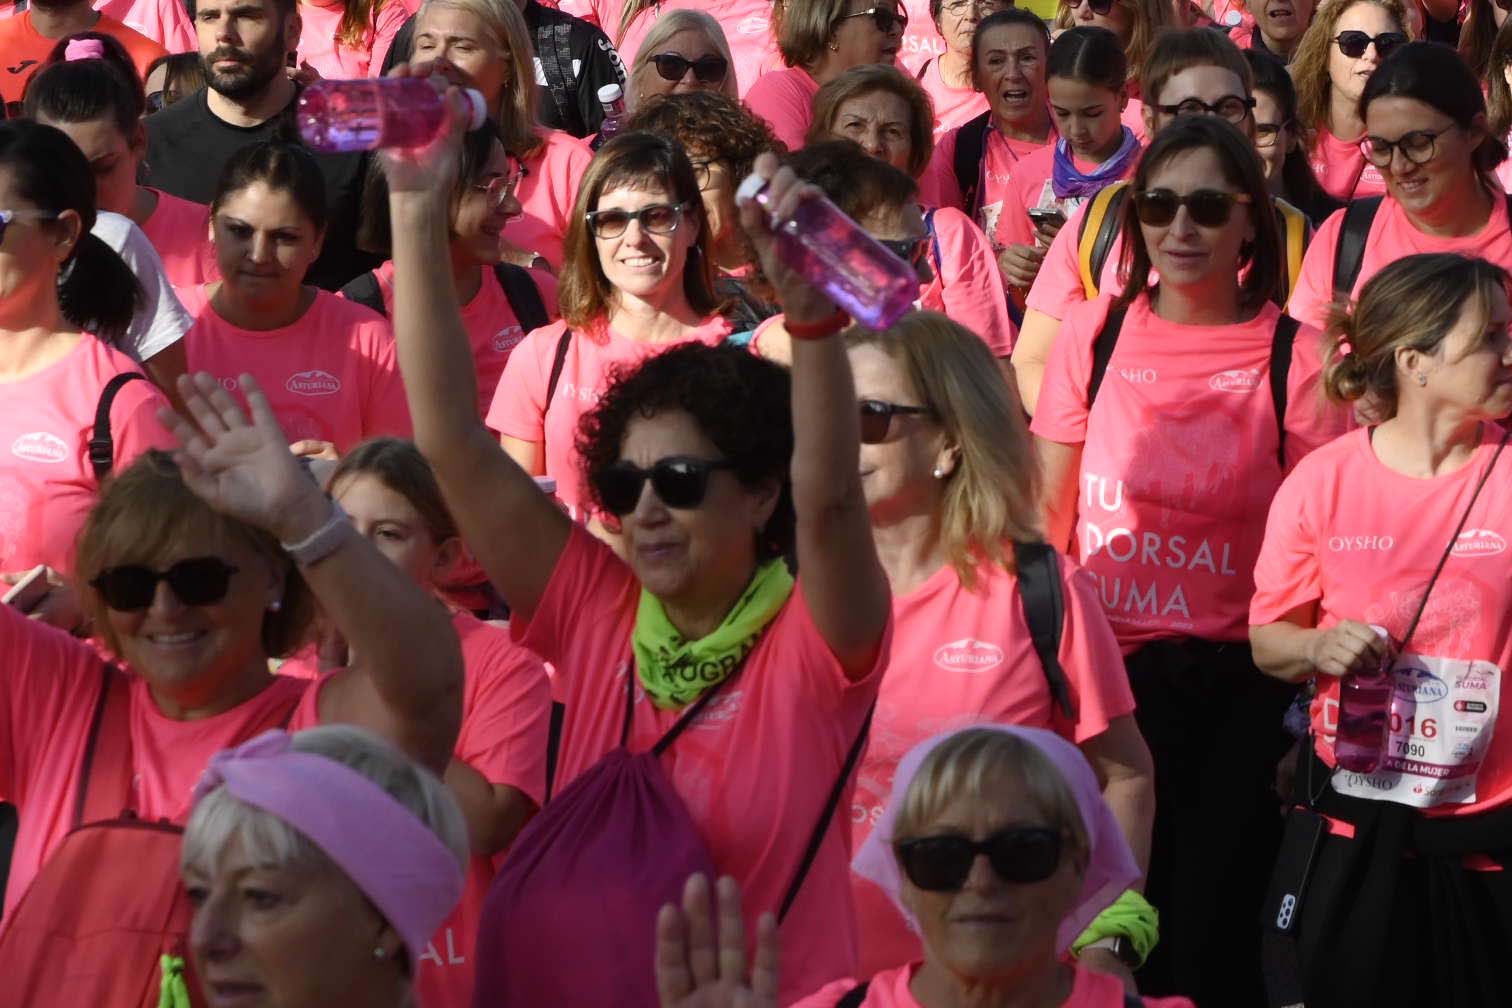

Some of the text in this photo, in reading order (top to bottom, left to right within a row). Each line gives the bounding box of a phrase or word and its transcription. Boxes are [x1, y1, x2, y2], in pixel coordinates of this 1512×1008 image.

[1085, 473, 1124, 512] TU
[1086, 522, 1236, 576] DORSAL
[1328, 535, 1394, 552] OYSHO
[1390, 712, 1438, 739] 016
[1397, 741, 1426, 758] 7090
[1420, 766, 1450, 777] MUJER
